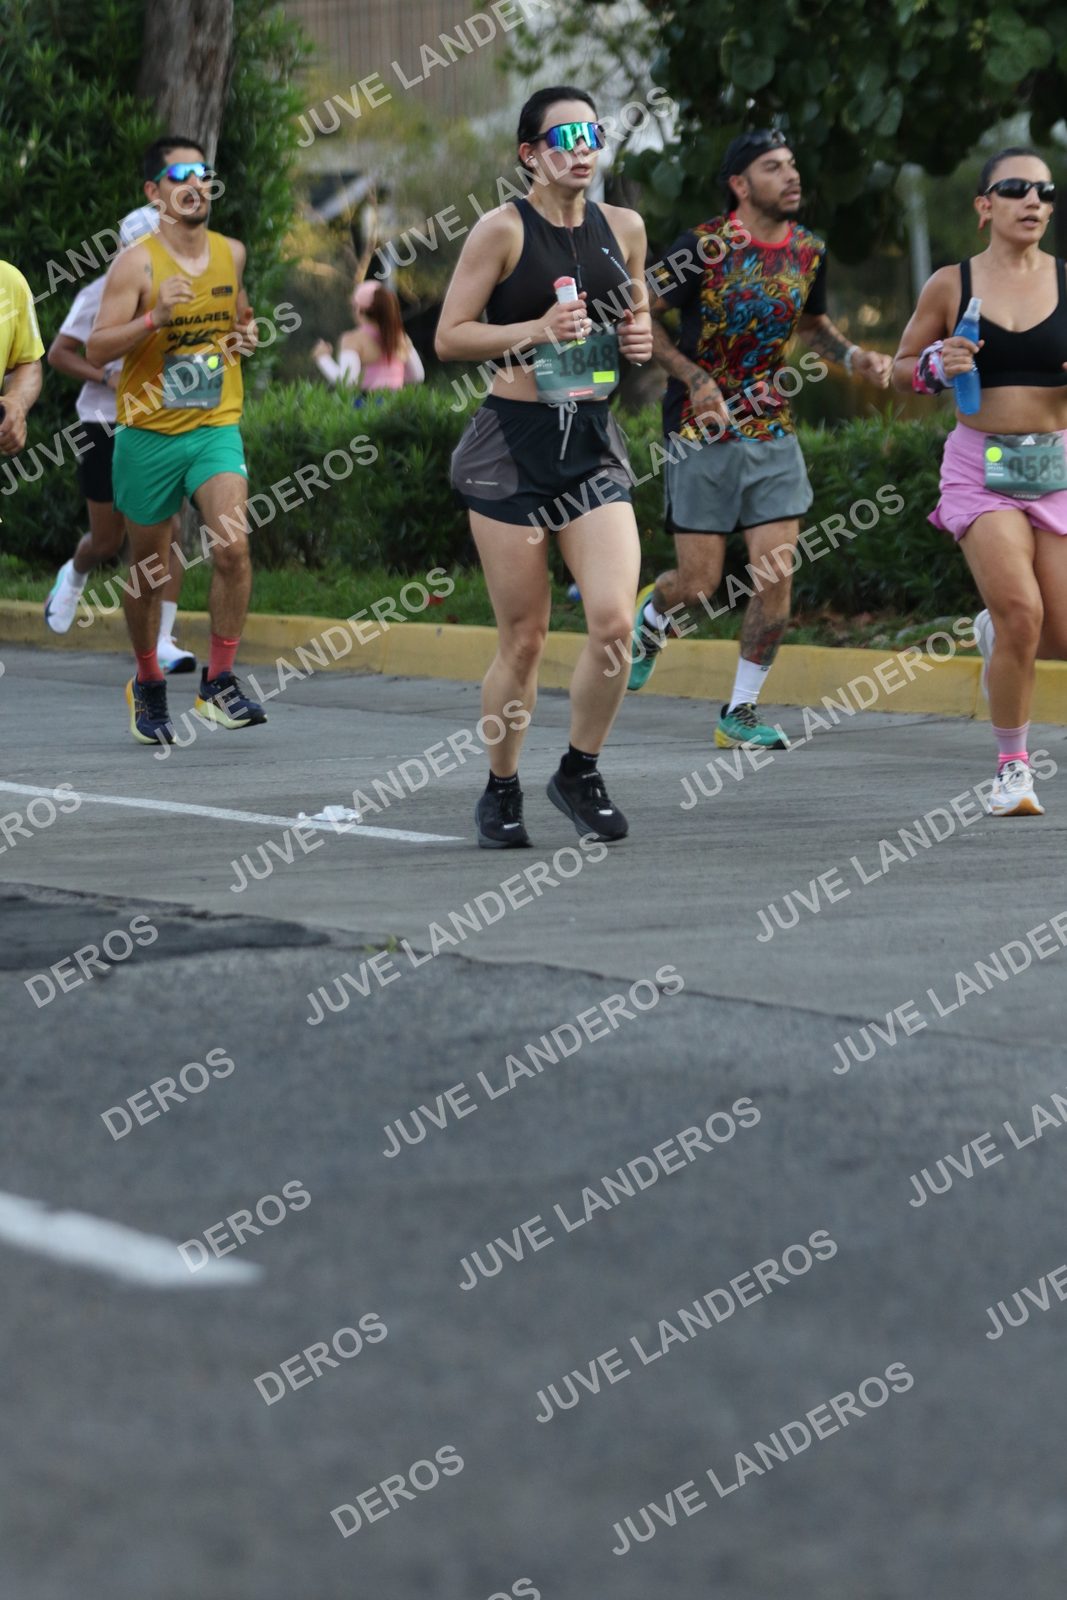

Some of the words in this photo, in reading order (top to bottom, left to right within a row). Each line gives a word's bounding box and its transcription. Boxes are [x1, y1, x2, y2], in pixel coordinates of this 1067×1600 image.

[163, 311, 230, 327] AGUARES
[558, 344, 615, 377] 1848
[1008, 454, 1065, 482] 0585
